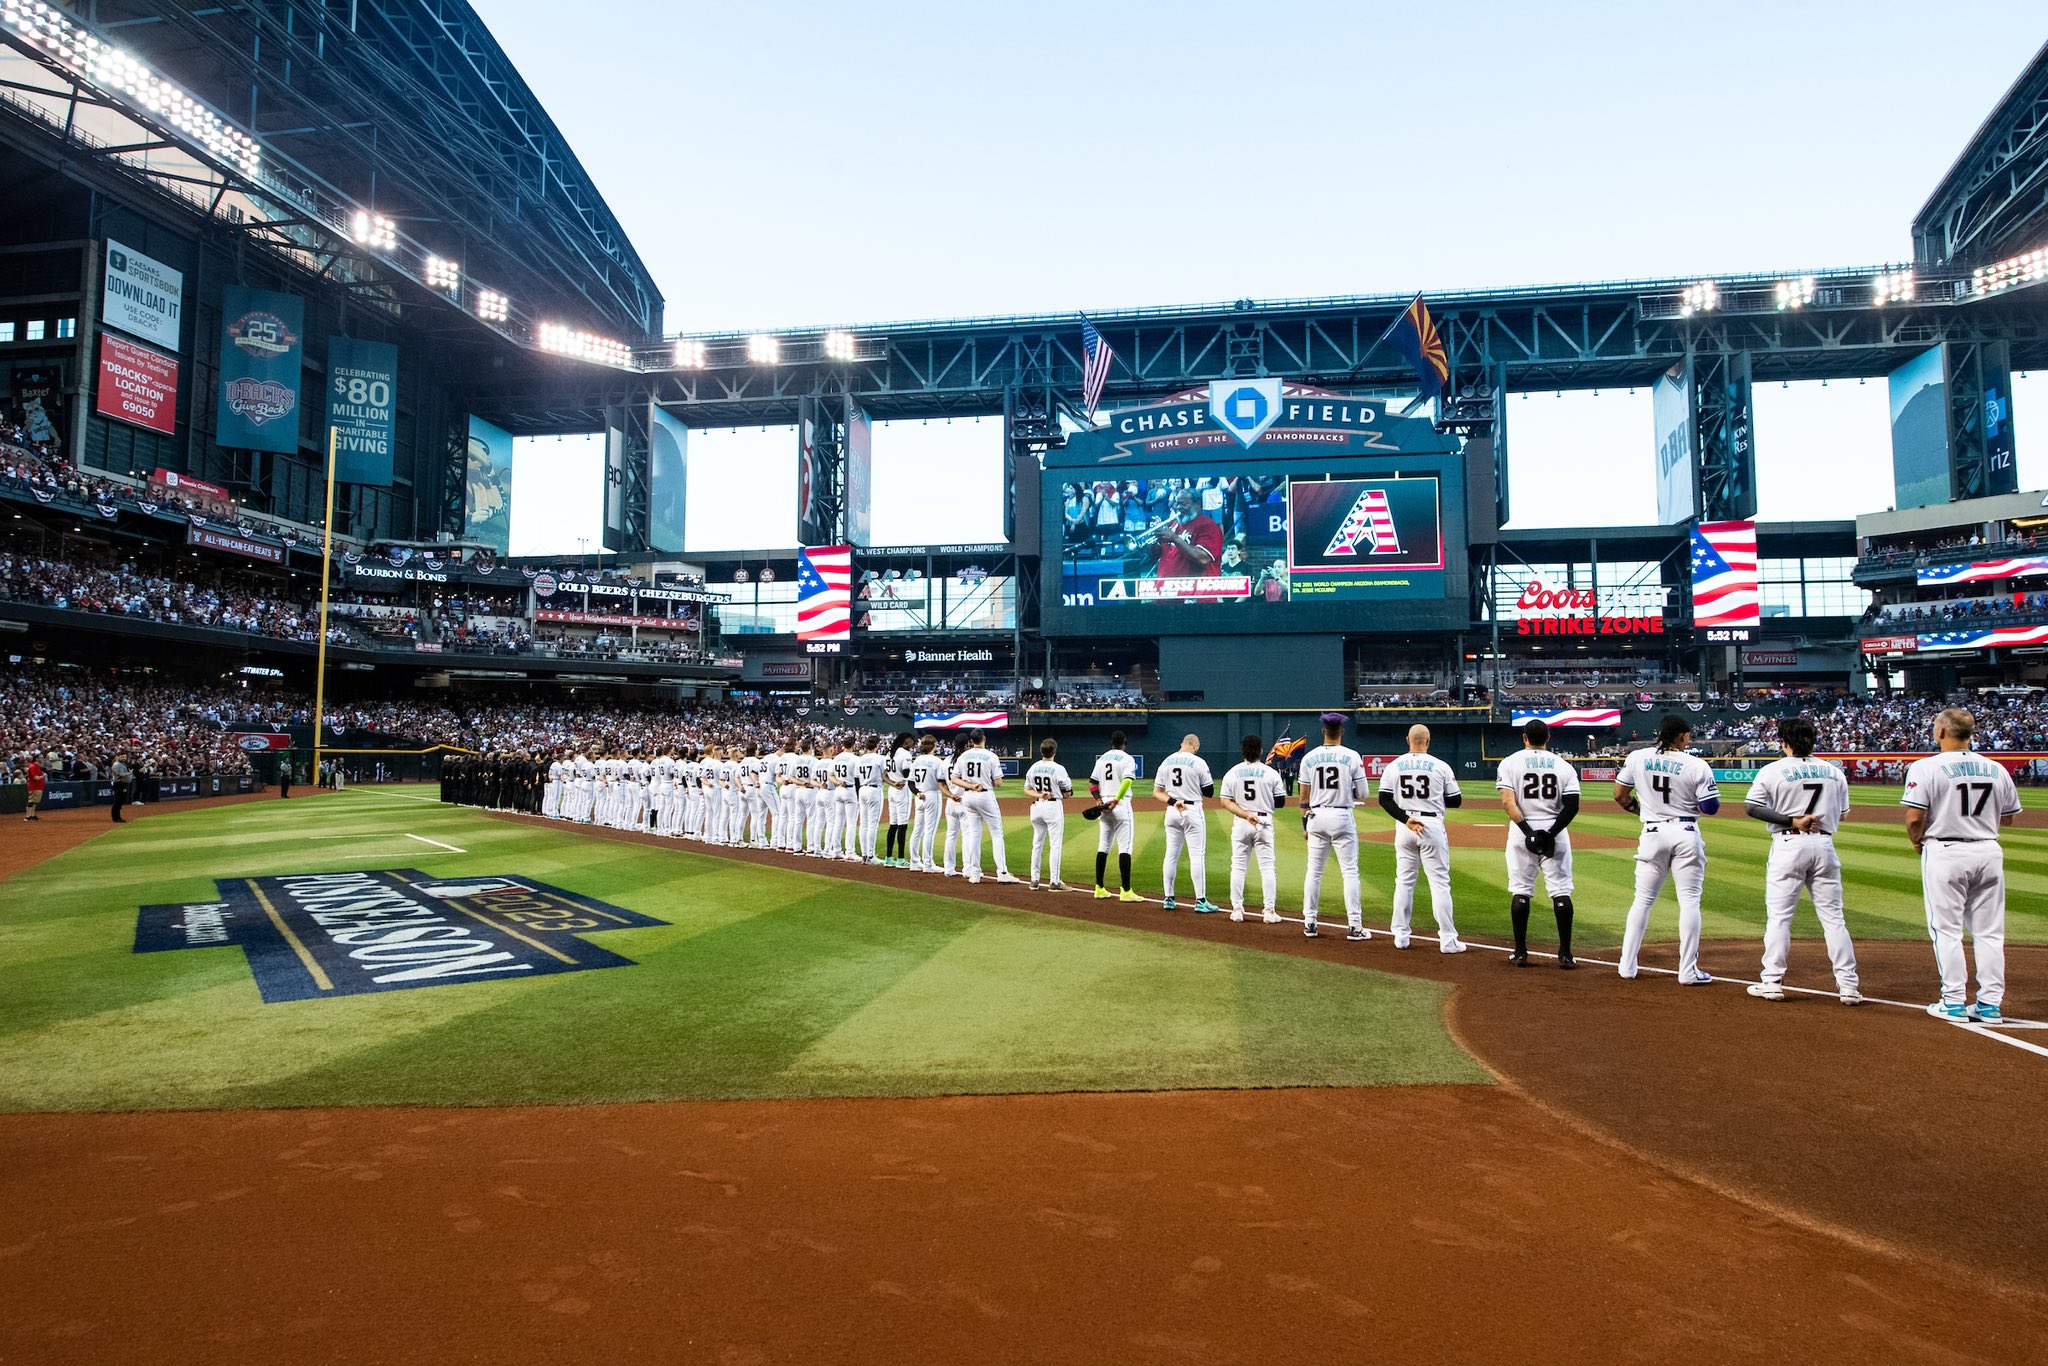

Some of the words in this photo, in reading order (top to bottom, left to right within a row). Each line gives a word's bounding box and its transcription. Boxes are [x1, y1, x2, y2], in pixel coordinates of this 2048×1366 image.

[129, 258, 160, 277] CAESARS
[128, 266, 180, 298] SPORTSBOOK
[107, 274, 166, 314] DOWNLOAD
[169, 301, 179, 319] IT
[123, 303, 138, 314] USE
[140, 310, 163, 326] CODE:
[128, 314, 158, 331] DBACKS
[248, 320, 277, 343] 25
[106, 337, 129, 351] Report
[131, 346, 150, 360] Guest
[150, 355, 177, 370] Conduct
[114, 350, 136, 364] Issues
[137, 358, 145, 368] by
[147, 362, 169, 377] Texting
[334, 367, 390, 381] CELEBRATING
[22, 387, 50, 398] Baxter
[115, 377, 164, 402] LOCATION
[121, 391, 133, 400] and
[134, 396, 150, 406] issue
[334, 376, 390, 407] $80
[122, 400, 155, 418] 69050
[231, 399, 258, 413] Give
[255, 402, 286, 417] Back
[333, 403, 389, 421] MILLION
[355, 419, 366, 428] IN
[1120, 408, 1204, 434] CHASE
[1289, 404, 1376, 424] FIELD
[1150, 439, 1181, 449] HOME
[1187, 436, 1201, 446] OF
[1206, 434, 1228, 443] THE
[1265, 432, 1345, 442] DIAMONDBACKS
[1990, 447, 2011, 472] riz
[179, 478, 197, 488] Phoenix
[151, 484, 233, 520] SANLOT
[205, 534, 254, 553] ALL-YOU-CAN-EAT
[254, 545, 272, 557] SEATS
[856, 548, 865, 556] NL
[886, 546, 926, 554] CHAMPIONS
[940, 545, 963, 553] WORLD
[964, 544, 1004, 552] CHAMPIONS
[355, 564, 403, 579] BOURBON
[404, 570, 415, 580] &
[416, 571, 448, 583] BONES
[557, 581, 590, 593] COLD
[591, 584, 629, 597] BEERS
[630, 588, 638, 598] &
[639, 588, 731, 605] CHEESEBURGERS
[1139, 579, 1158, 592] DR.
[1159, 579, 1195, 592] JESSE
[1195, 578, 1248, 591] MCGUIRE
[1517, 580, 1598, 610] Coors
[870, 601, 888, 609] WILD
[889, 601, 909, 609] CARD
[568, 612, 584, 622] Your
[584, 613, 621, 625] Neighborhood
[621, 616, 642, 626] Burger
[642, 618, 657, 627] Joint
[1517, 616, 1596, 635] STRIKE
[1600, 615, 1664, 634] ZONE
[1706, 630, 1730, 641] 5:52
[1732, 630, 1749, 640] PM
[806, 643, 826, 653] 5:52
[826, 643, 841, 652] PM
[1891, 641, 1916, 649] METER
[917, 650, 956, 662] Banner
[957, 649, 993, 661] Health
[759, 761, 768, 773] 35
[779, 763, 788, 776] 37
[885, 759, 897, 773] 50
[966, 761, 982, 778] 81
[1306, 752, 1338, 769] GURRIEL
[1397, 759, 1436, 772] WALKER
[1464, 761, 1477, 769] 413
[1525, 756, 1556, 769] PHAM
[1643, 758, 1684, 776] MARTE
[741, 765, 750, 777] 31
[796, 766, 809, 778] 38
[816, 769, 828, 782] 40
[834, 764, 848, 778] 43
[859, 765, 873, 779] 47
[914, 768, 927, 783] 57
[1105, 762, 1113, 780] 2
[1172, 767, 1183, 787] 3
[1316, 766, 1339, 789] 12
[1724, 770, 1753, 780] COX
[1781, 764, 1839, 783] CARROLL
[1941, 761, 1999, 779] LOVULLO
[1033, 775, 1052, 792] 99
[1243, 780, 1256, 801] 5
[1399, 774, 1430, 799] 53
[1523, 772, 1557, 800] 28
[1652, 775, 1671, 804] 4
[1803, 783, 1824, 815] 7
[1956, 782, 1993, 817] 17
[474, 892, 602, 933] 2023
[170, 903, 236, 945] Booking.com
[275, 872, 535, 985] POSTSEASON
